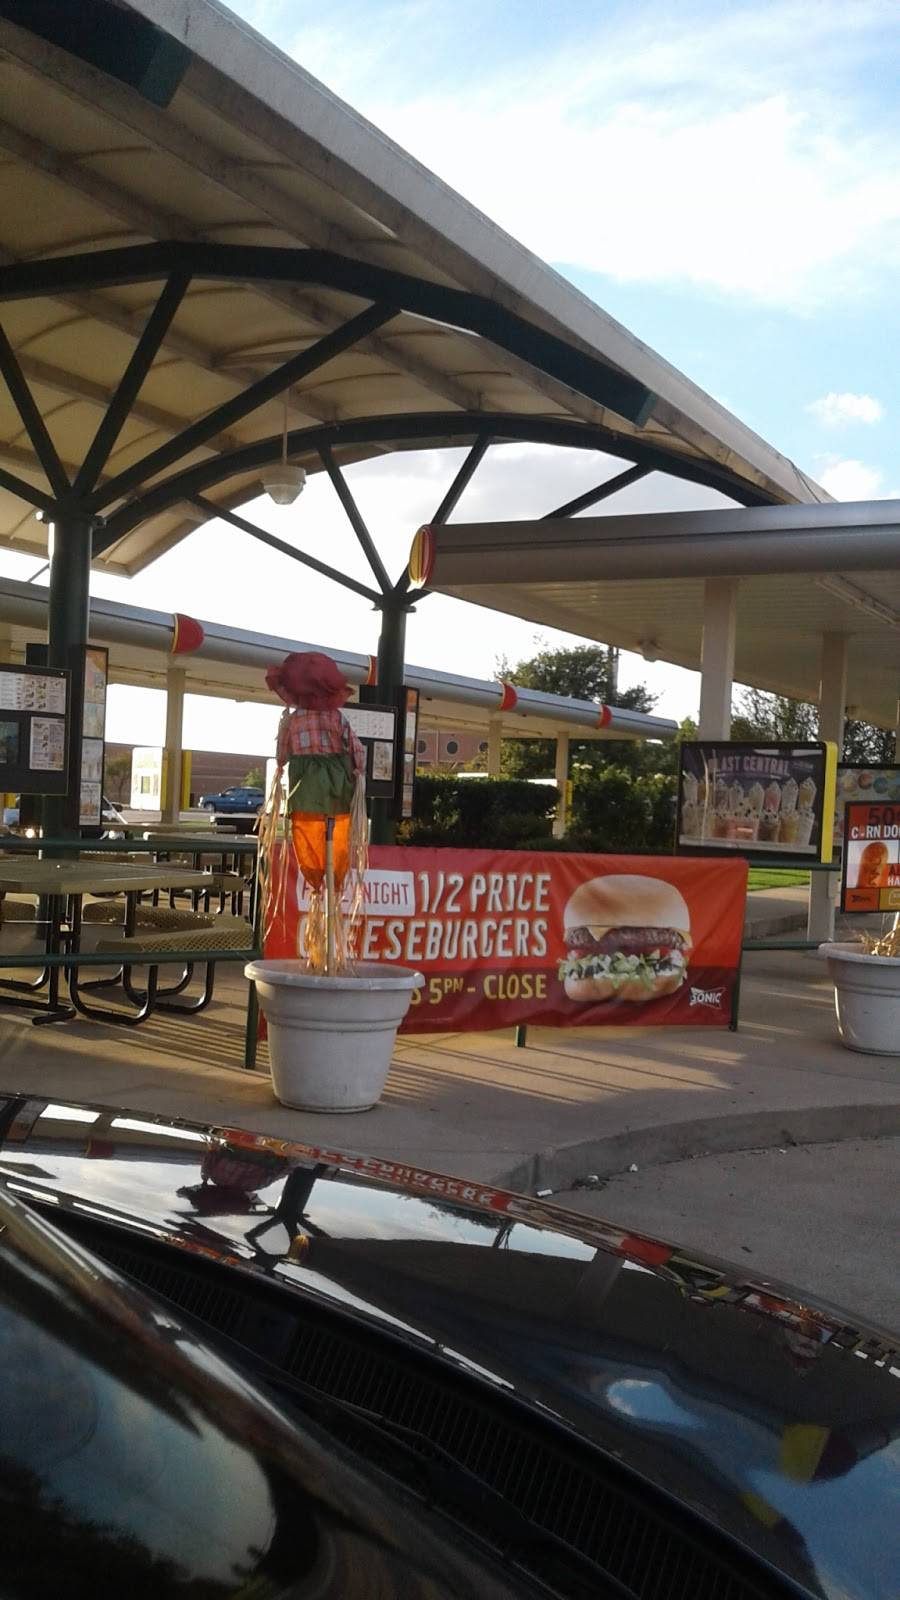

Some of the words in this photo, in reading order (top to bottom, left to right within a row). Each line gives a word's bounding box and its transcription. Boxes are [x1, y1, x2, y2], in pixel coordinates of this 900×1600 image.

[743, 756, 791, 777] CENTRAL
[851, 825, 881, 840] CRN
[363, 882, 409, 905] NIGHT
[419, 872, 464, 914] 1/2
[470, 873, 552, 913] PRICE
[483, 974, 547, 1000] CLOSE
[690, 991, 723, 1004] SONIC
